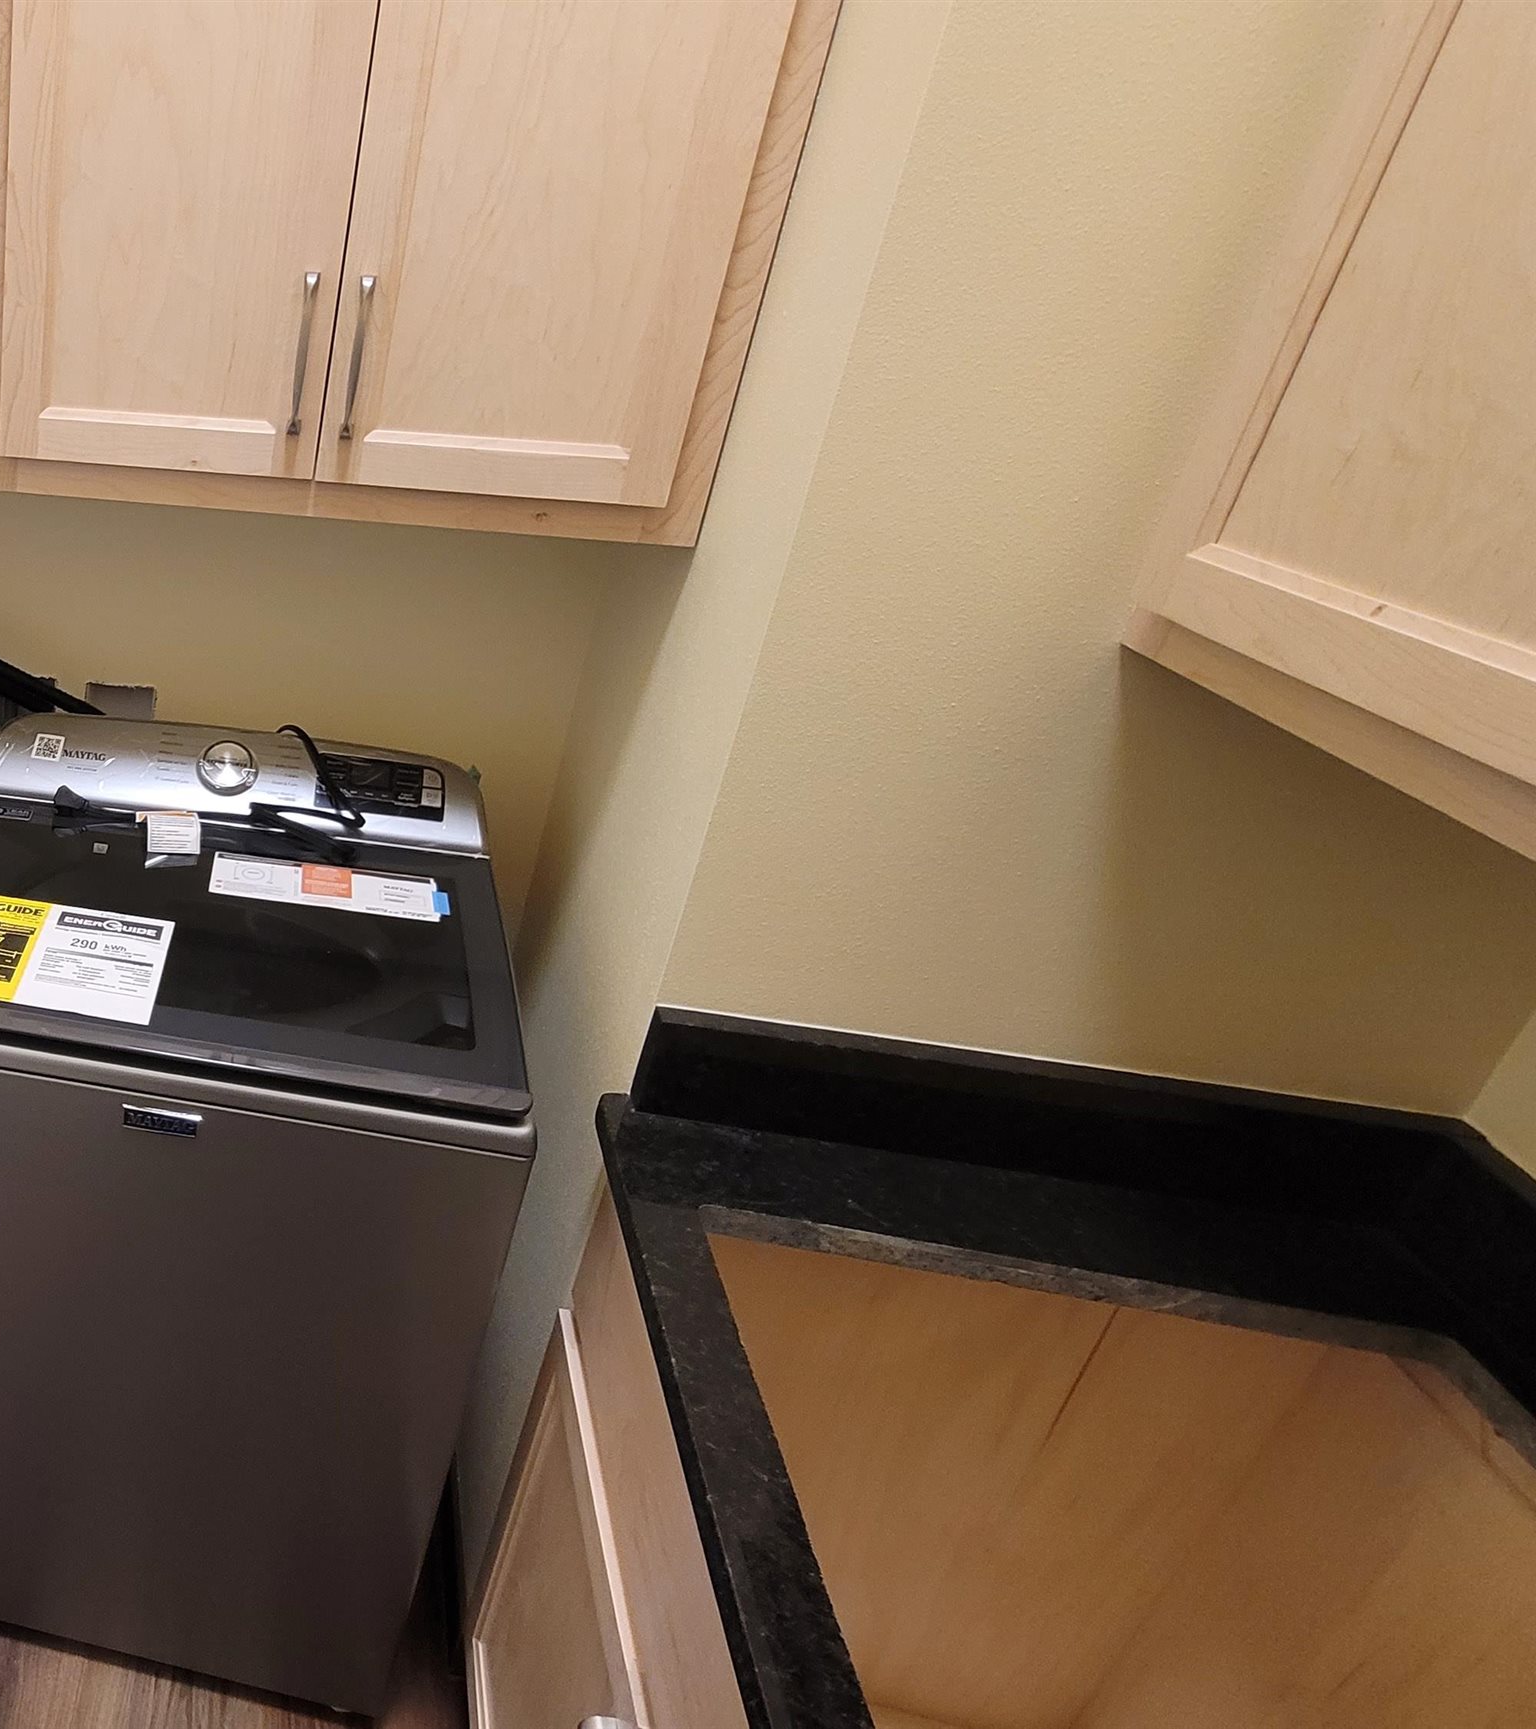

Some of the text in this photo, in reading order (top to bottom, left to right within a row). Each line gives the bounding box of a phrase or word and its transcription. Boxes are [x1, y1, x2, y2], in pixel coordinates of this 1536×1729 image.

[62, 749, 106, 762] MAYTAG
[70, 938, 127, 952] 290 kWh
